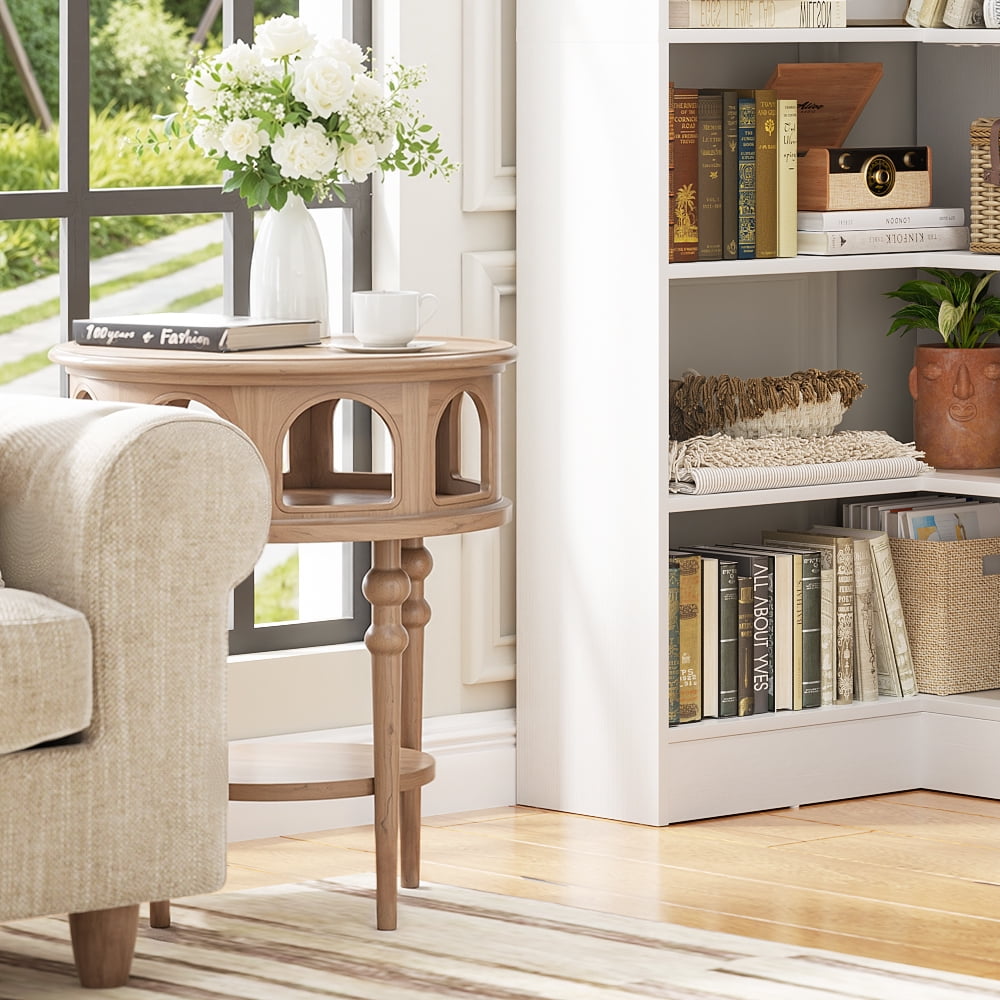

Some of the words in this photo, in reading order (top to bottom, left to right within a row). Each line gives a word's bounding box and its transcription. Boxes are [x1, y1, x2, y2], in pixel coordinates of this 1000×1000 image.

[885, 216, 911, 224] LONDON
[885, 232, 925, 244] KINFOLK
[159, 328, 211, 346] Fashion
[753, 563, 769, 592] ALL
[753, 595, 769, 648] ABOUT
[753, 653, 769, 692] YVES
